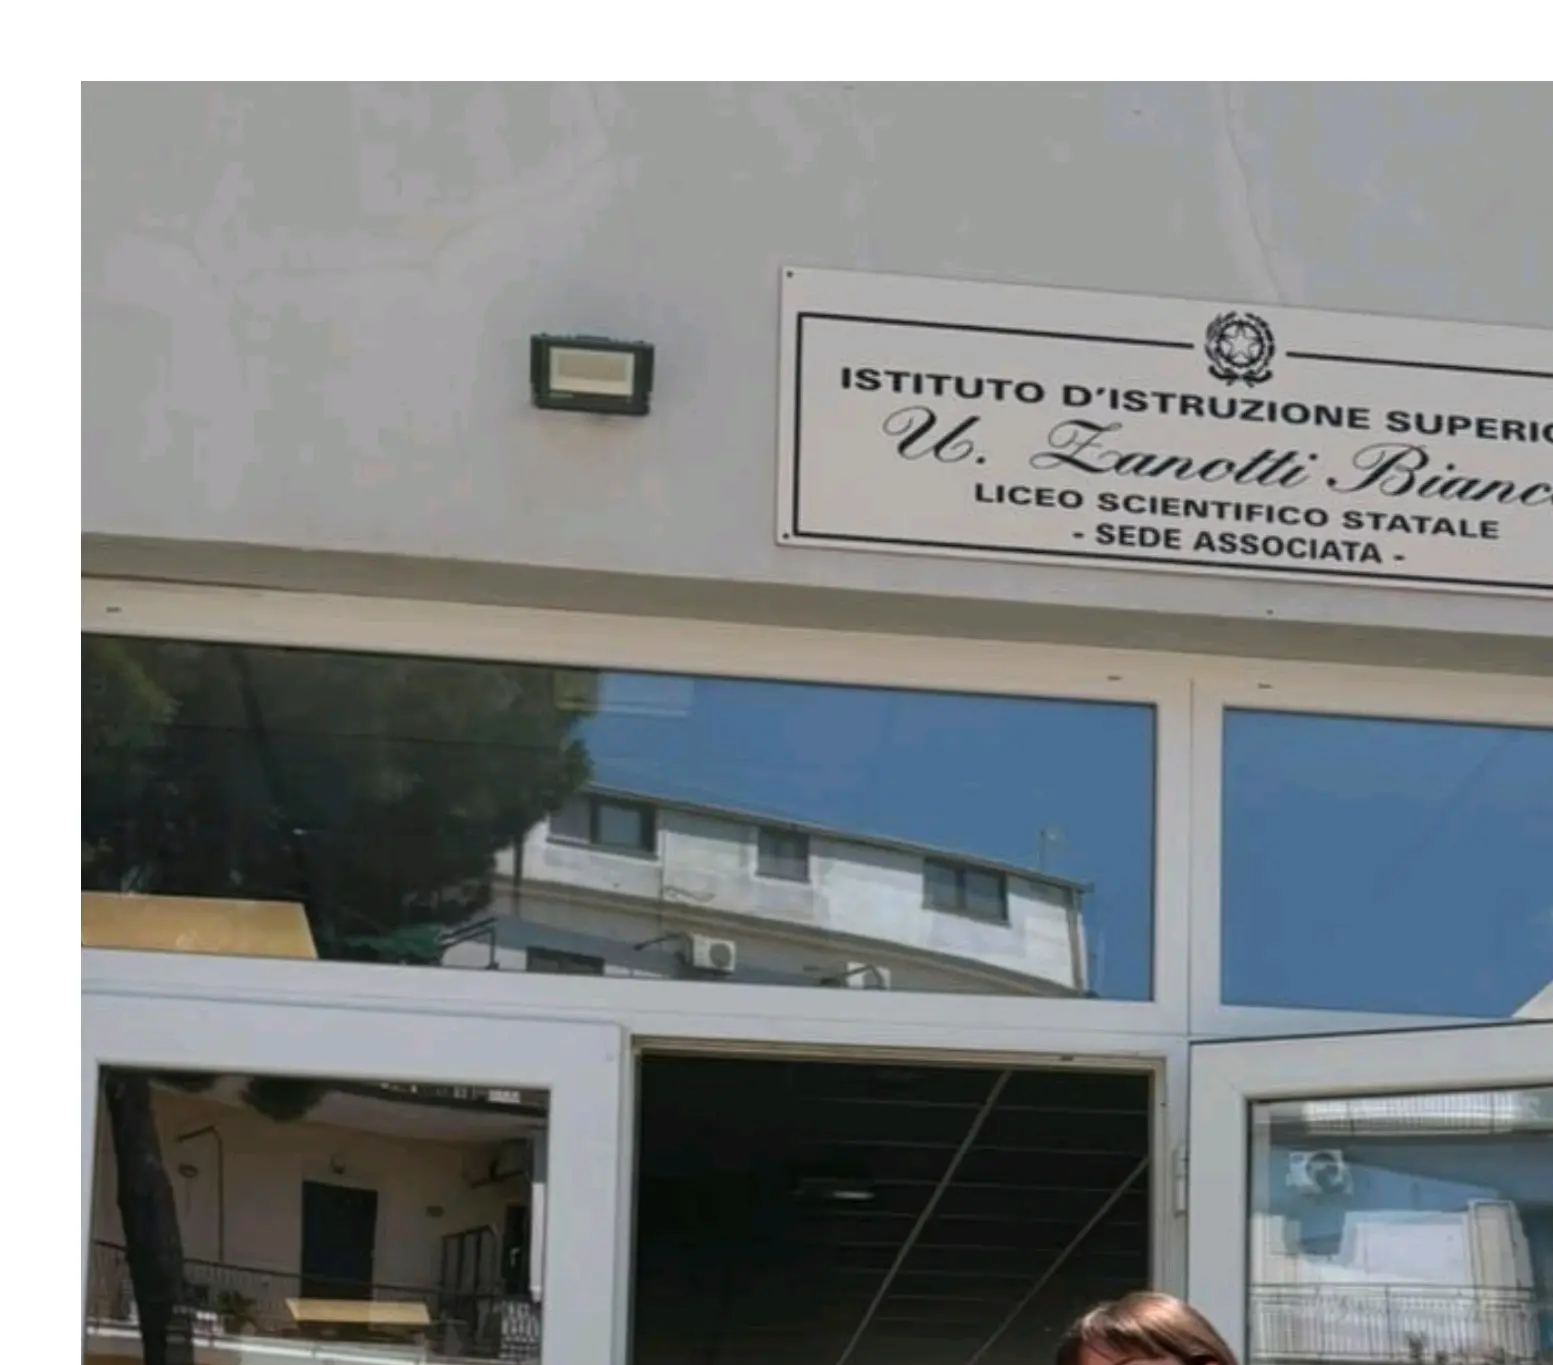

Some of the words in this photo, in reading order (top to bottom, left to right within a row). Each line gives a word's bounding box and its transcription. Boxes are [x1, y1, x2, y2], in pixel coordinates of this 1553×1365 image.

[842, 368, 1045, 404] ISTITUTO
[1063, 385, 1370, 433] D'ISTRUZIONE
[882, 405, 987, 466] U.
[1030, 419, 1319, 491] Zanotti
[976, 484, 1084, 509] LICEO
[1098, 493, 1328, 527] SCIENTIFICO
[1343, 511, 1498, 540] STATALE
[1096, 523, 1181, 550] SEDE
[1194, 531, 1382, 564] ASSOCIATA
